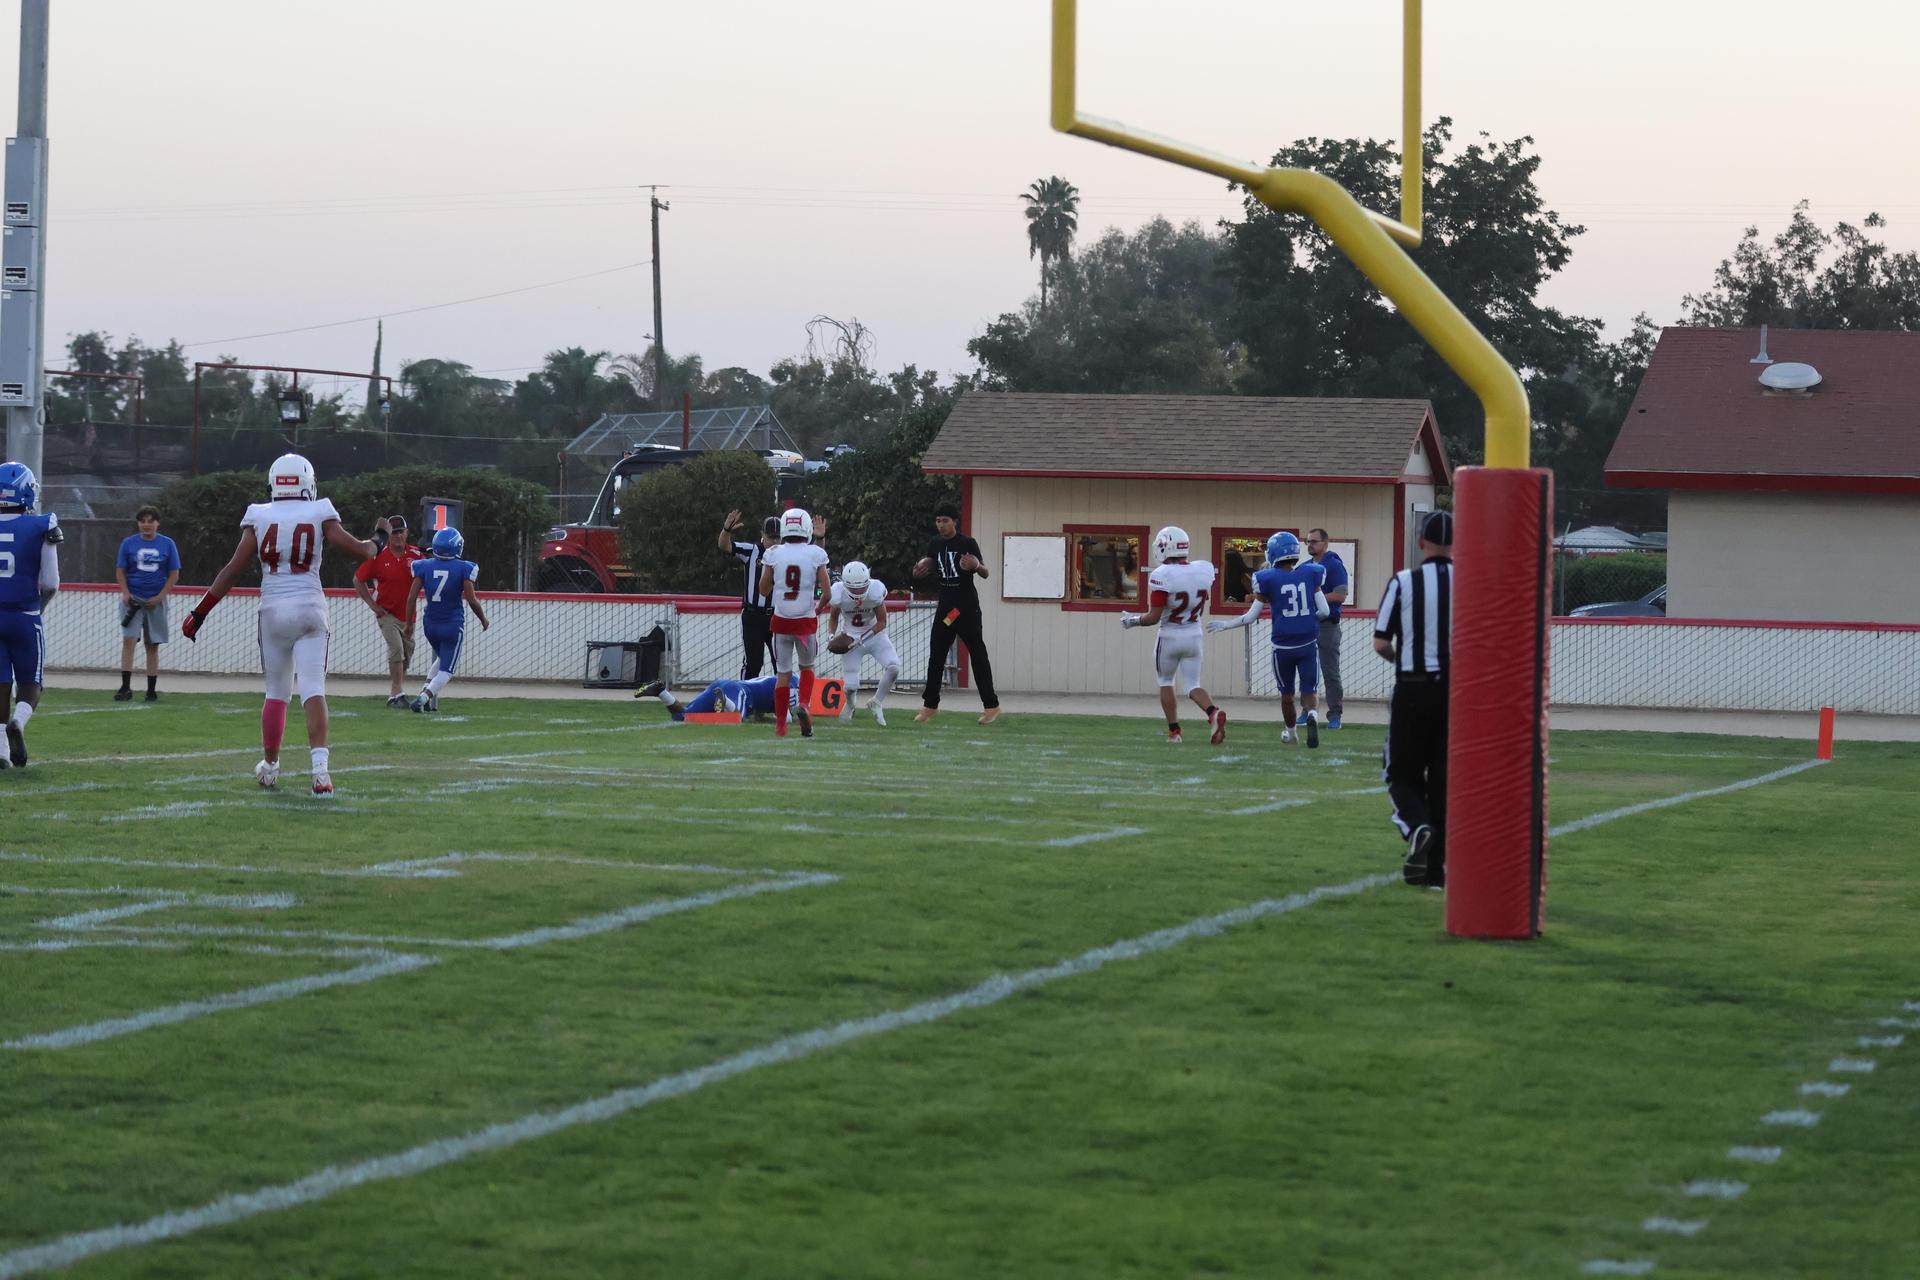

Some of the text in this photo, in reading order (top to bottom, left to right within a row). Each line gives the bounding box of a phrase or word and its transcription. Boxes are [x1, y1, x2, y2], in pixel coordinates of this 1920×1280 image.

[433, 504, 447, 531] 1
[137, 548, 160, 572] C
[260, 522, 315, 575] 40
[433, 570, 449, 602] 7
[784, 565, 801, 600] 9
[1281, 583, 1309, 616] 31
[821, 682, 841, 709] G
